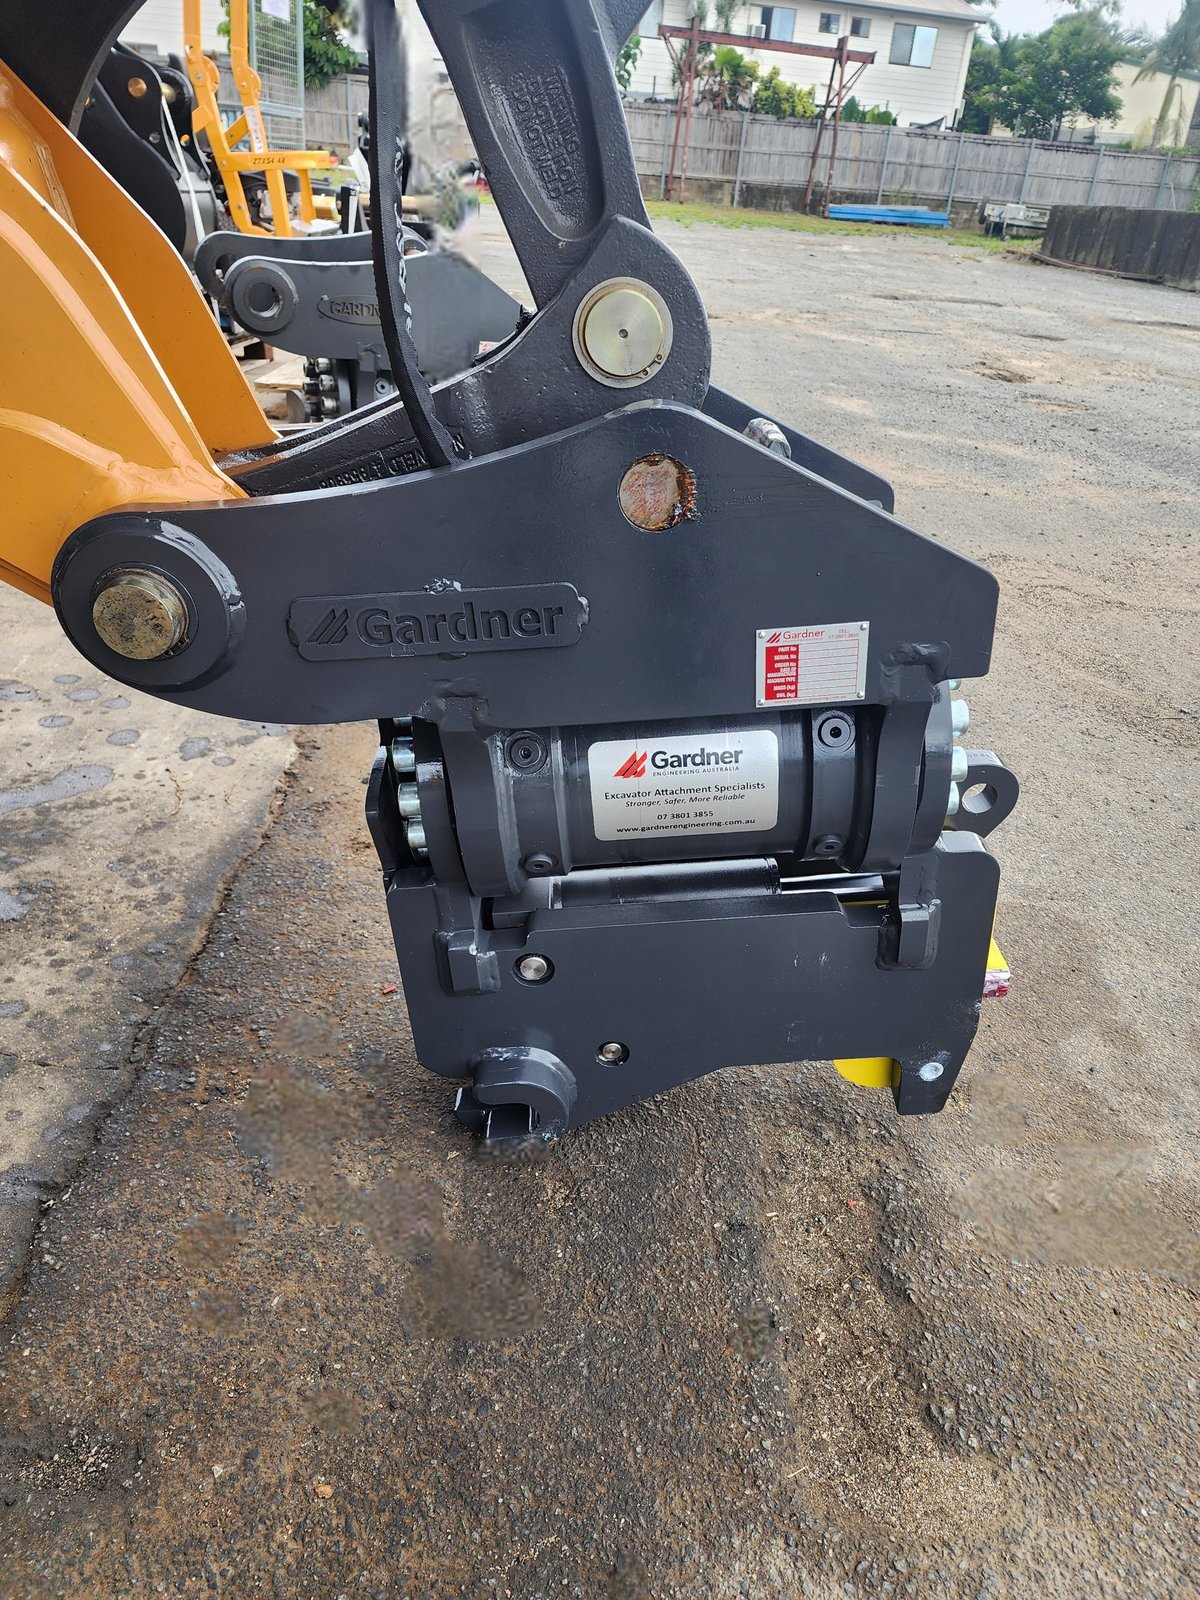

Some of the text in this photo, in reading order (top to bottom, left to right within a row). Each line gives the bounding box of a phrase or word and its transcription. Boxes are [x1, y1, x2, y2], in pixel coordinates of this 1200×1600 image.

[525, 80, 563, 150] DUCTILE
[536, 150, 563, 199] WELD
[329, 301, 380, 317] GARDN
[356, 602, 563, 647] Gardner
[783, 629, 825, 640] Gardner
[651, 748, 743, 769] Gardner
[652, 766, 740, 777] ENGINEERING AUSTRALIA
[604, 782, 766, 800] Excavator Attachment Specialists
[625, 793, 745, 808] Stronger, Safer, More Reliable
[693, 810, 714, 818] 3855
[616, 818, 756, 833] www.gardnerengineering.com.au
